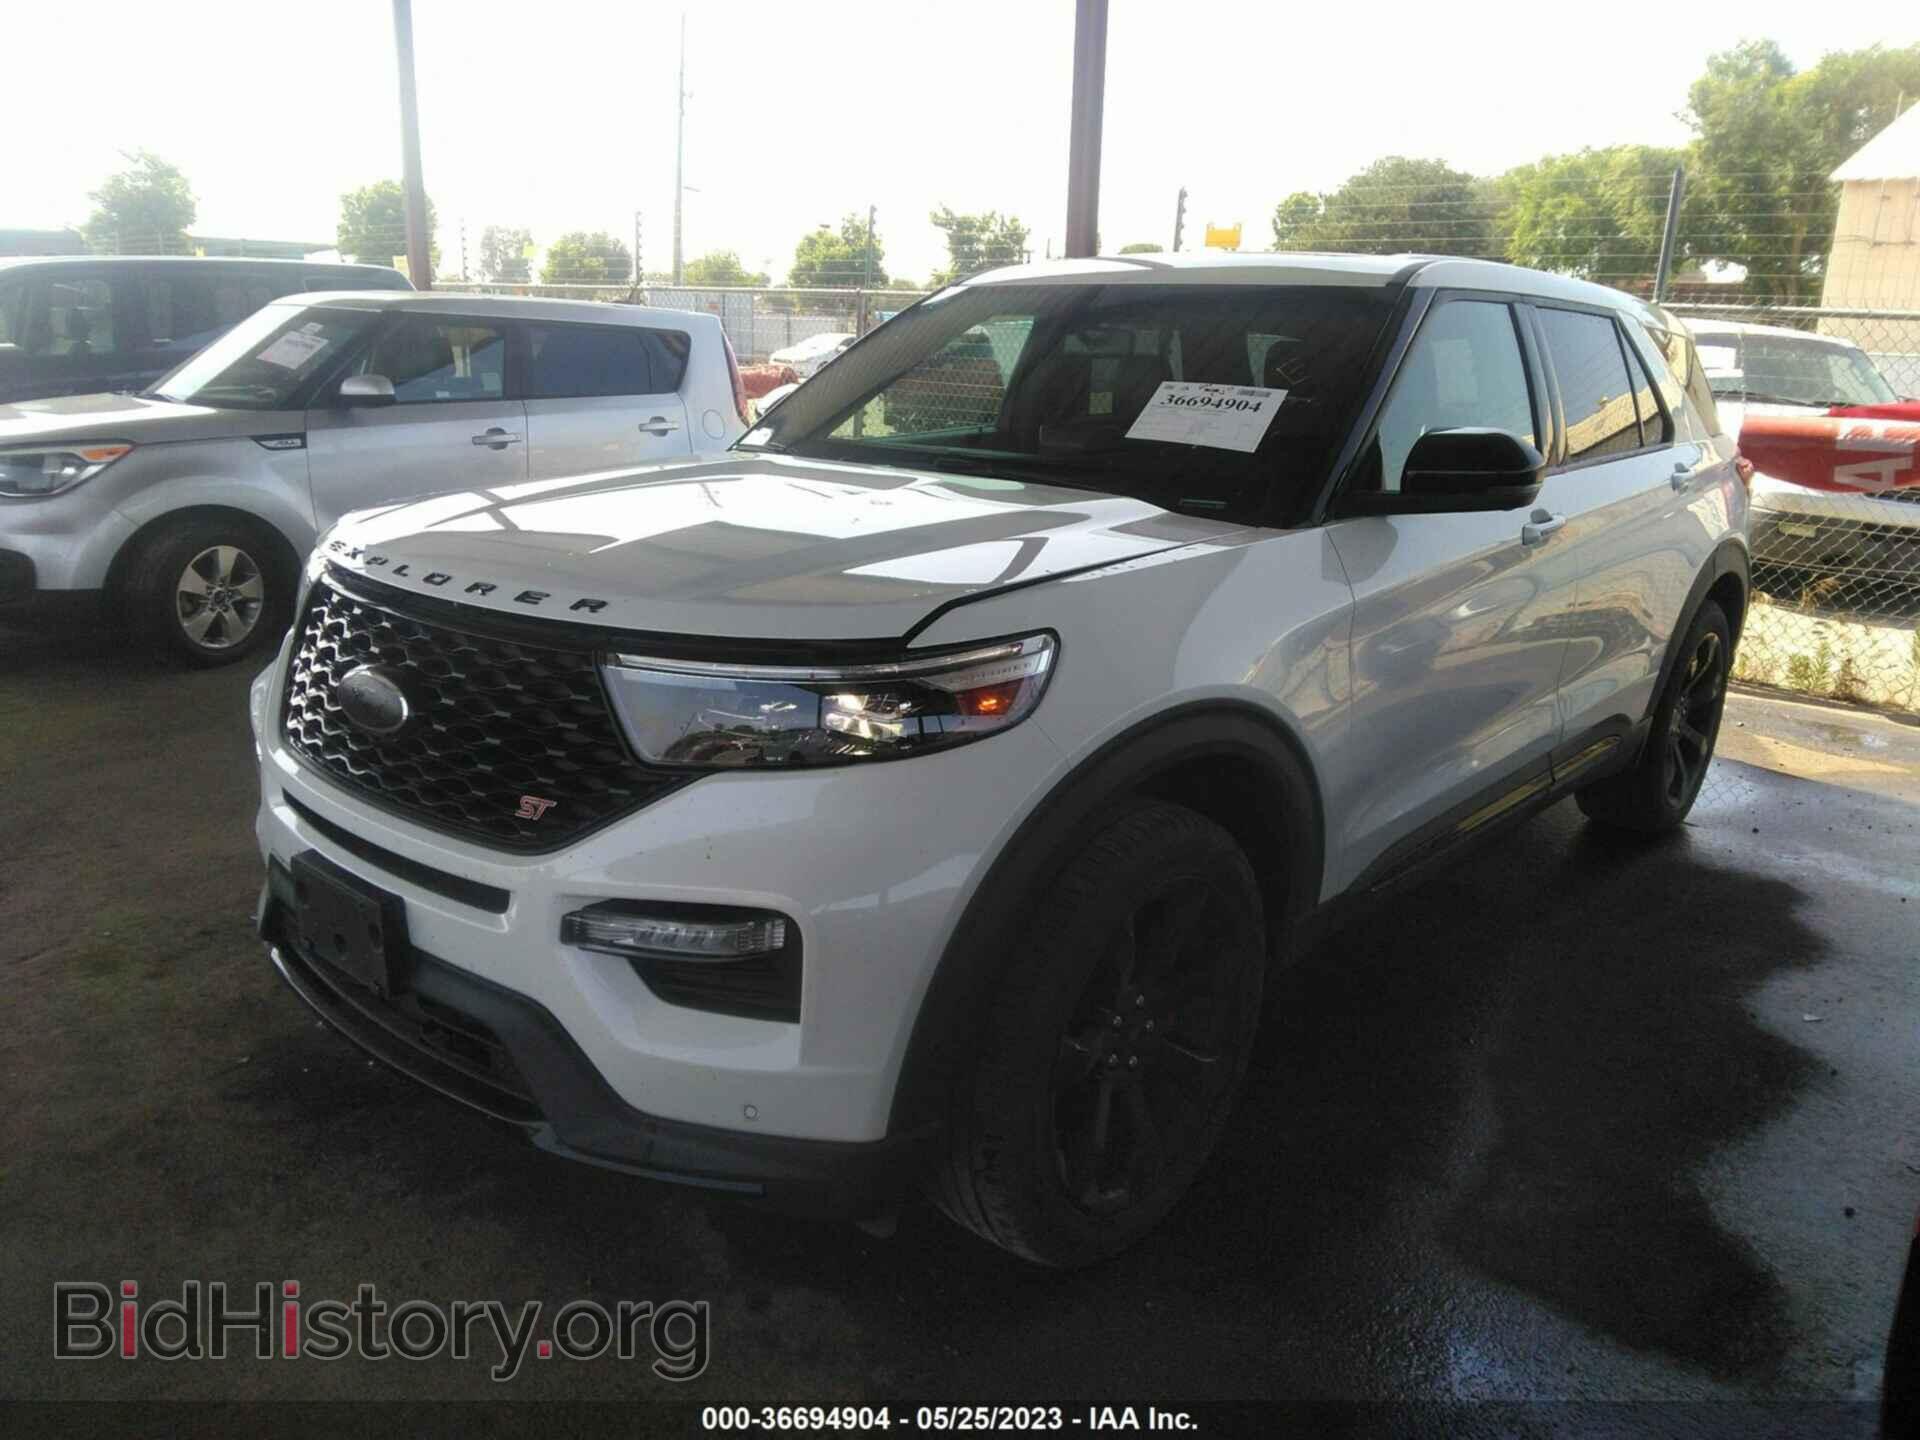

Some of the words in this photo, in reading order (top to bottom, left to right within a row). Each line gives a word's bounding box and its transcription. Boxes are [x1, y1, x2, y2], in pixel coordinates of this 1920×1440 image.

[1160, 394, 1262, 412] 36694904
[328, 541, 609, 613] EXPLORER
[514, 795, 558, 820] ST
